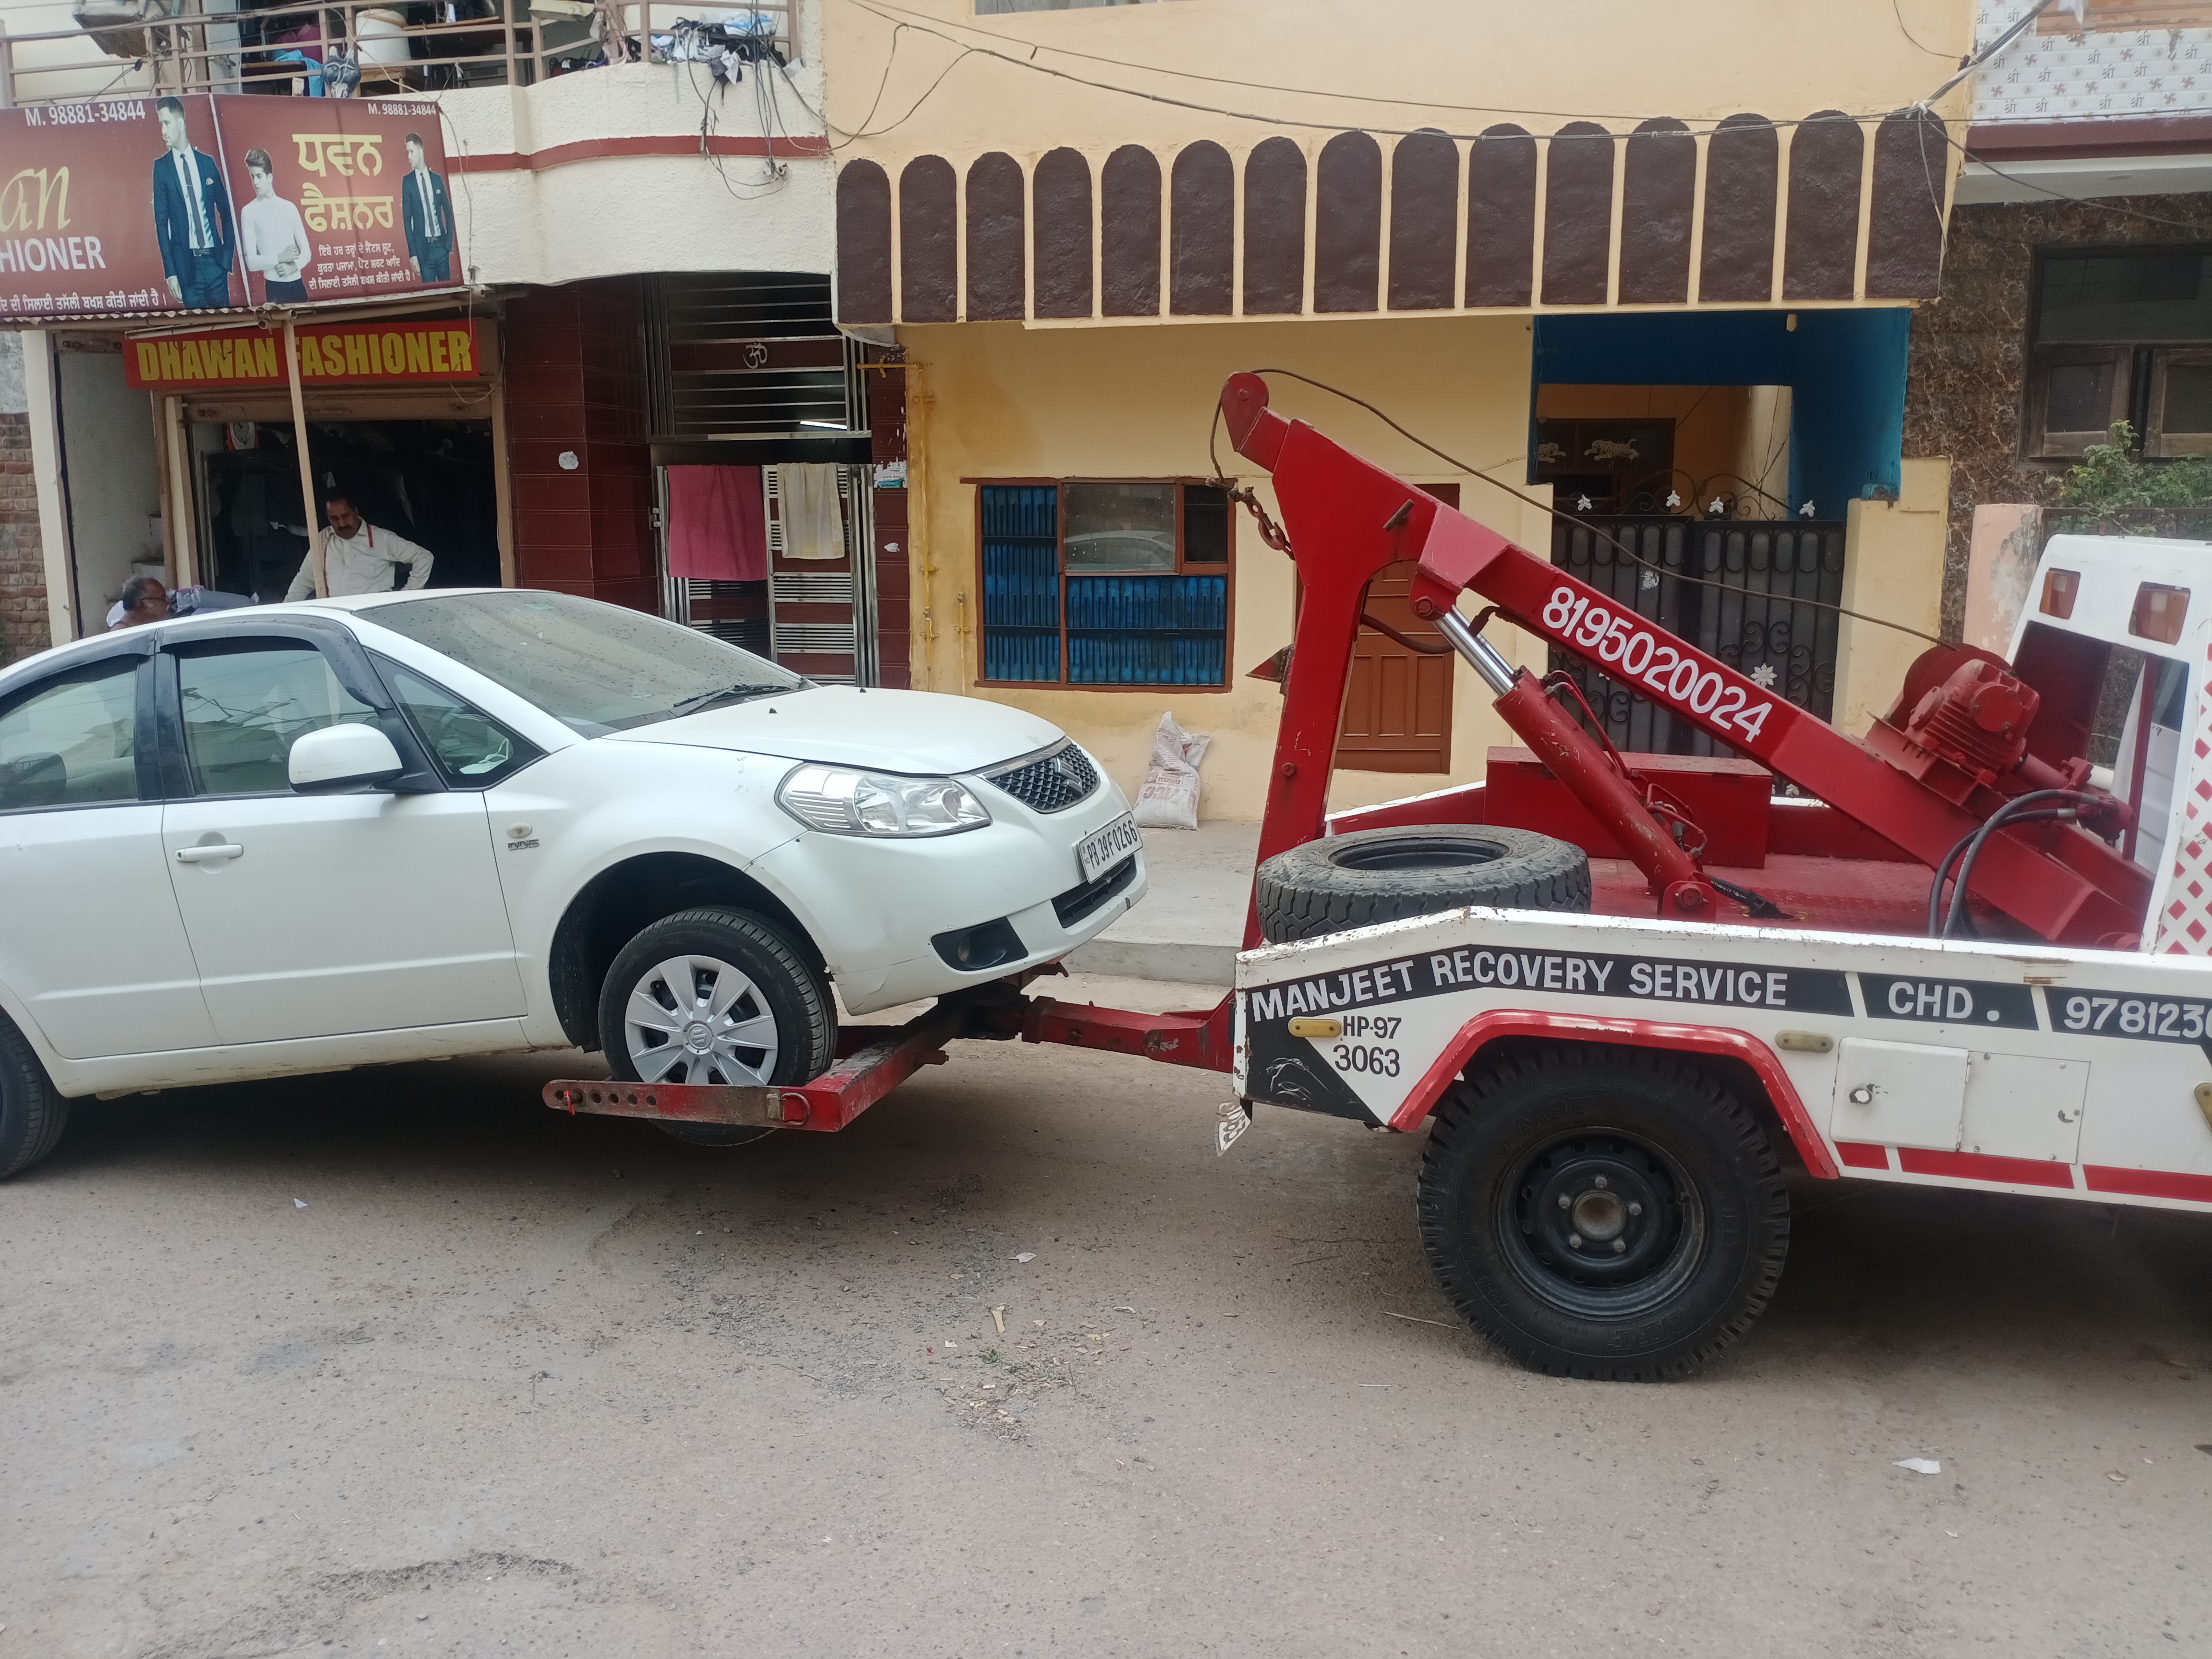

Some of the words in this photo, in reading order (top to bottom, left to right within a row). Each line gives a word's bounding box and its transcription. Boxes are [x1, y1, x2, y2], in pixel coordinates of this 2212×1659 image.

[25, 108, 46, 126] M.
[48, 100, 145, 126] 98881-34844
[368, 103, 381, 115] M.
[382, 103, 436, 116] 98881-34844
[292, 133, 383, 177] ਧਵਨ
[333, 246, 344, 255] ਹਰ
[358, 241, 364, 254] ਦੇ
[308, 277, 317, 290] ਦੀ
[318, 276, 341, 289] ਸਿਲਾਈ
[375, 271, 390, 283] ਕੀਤੀ
[405, 268, 411, 281] ਹੈ
[10, 294, 22, 312] ਦੀ
[23, 293, 54, 311] ਸਿਲਾਈ
[55, 292, 80, 310] ਤਸੱਲੀ
[105, 290, 126, 308] ਕੀਤੀ
[150, 288, 159, 306] ਹੈ
[136, 337, 278, 381] DHAWAN
[1542, 586, 1773, 743] 8195020024
[1251, 960, 1414, 1022] MANJEET
[1430, 950, 1614, 992] RECOVERY
[1629, 962, 1788, 1006] SERVICE
[1333, 1044, 1400, 1077] 3063
